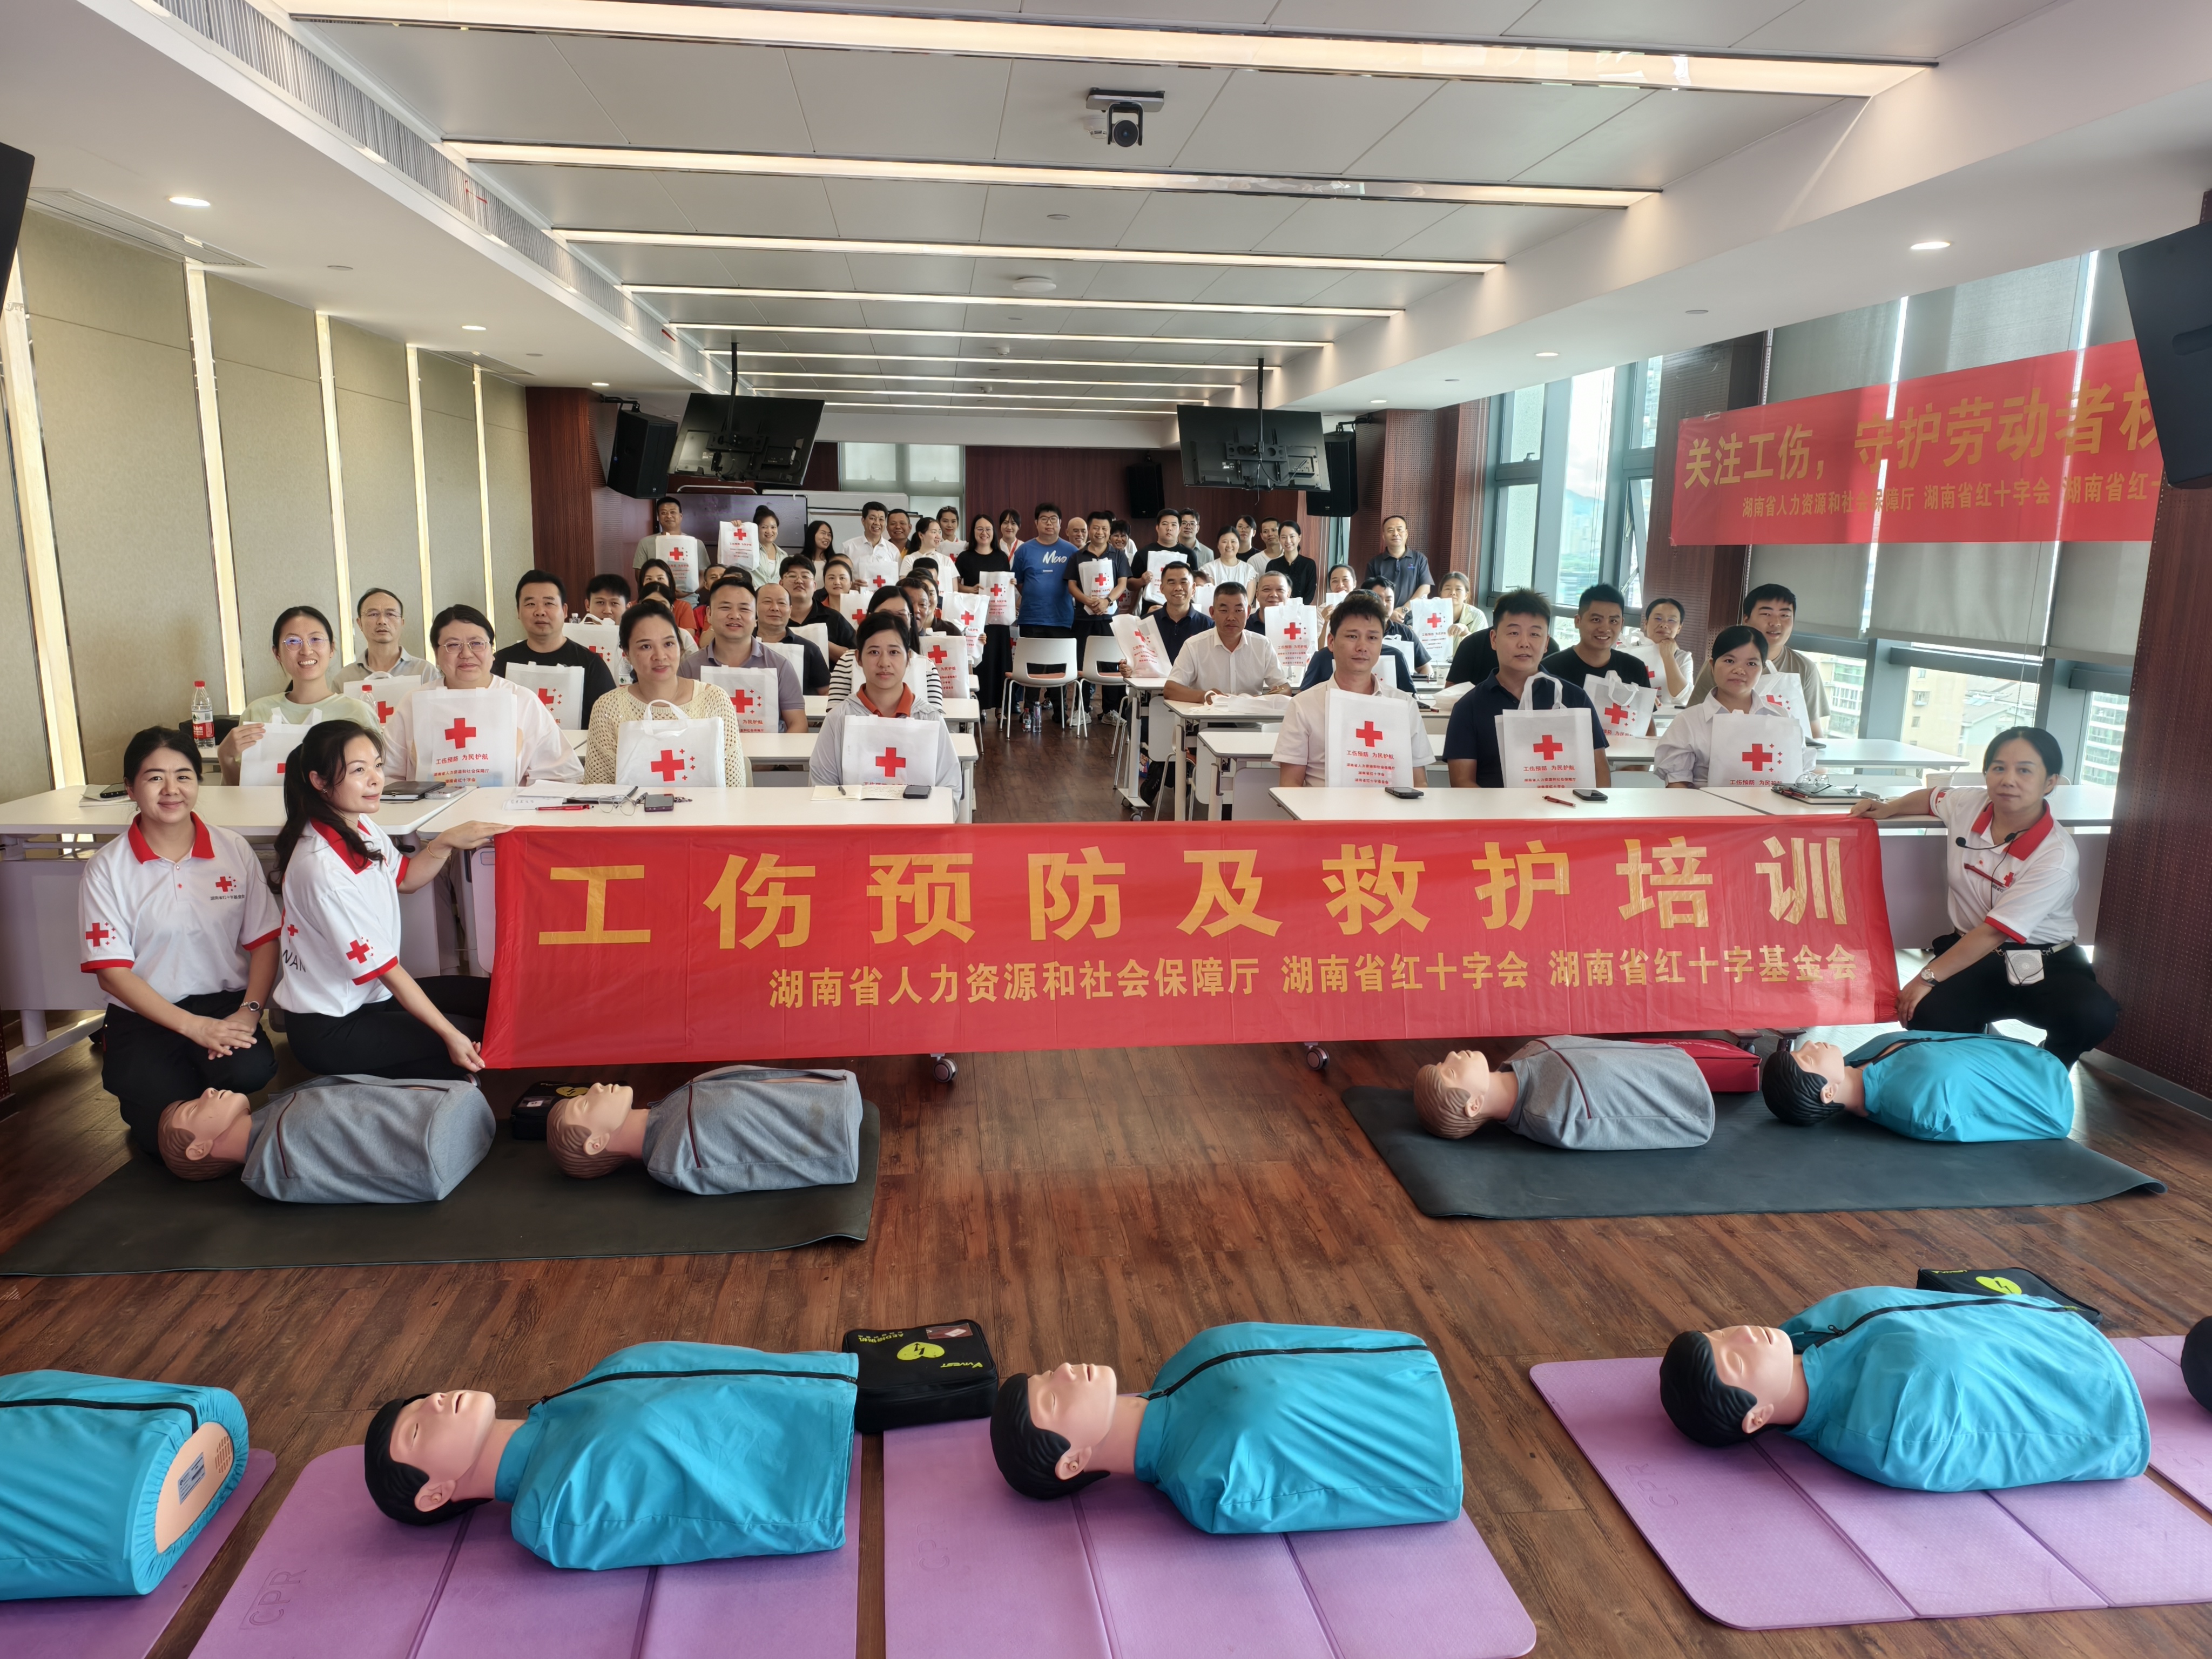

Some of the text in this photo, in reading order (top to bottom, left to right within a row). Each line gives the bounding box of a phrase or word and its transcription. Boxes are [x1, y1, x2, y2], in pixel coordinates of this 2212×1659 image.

[1742, 487, 1914, 517] 湖南省人力资源和社会保障厅
[1924, 478, 2051, 511] 湖南省红十字会
[436, 756, 458, 765] 工伤预防
[539, 835, 1847, 950] 工伤预防及救护培训
[769, 943, 1858, 1009] 湖南省人力资源和社会保障厅 湖南省红十字会 湖南省红十字基金会
[249, 1569, 307, 1626] CPR
